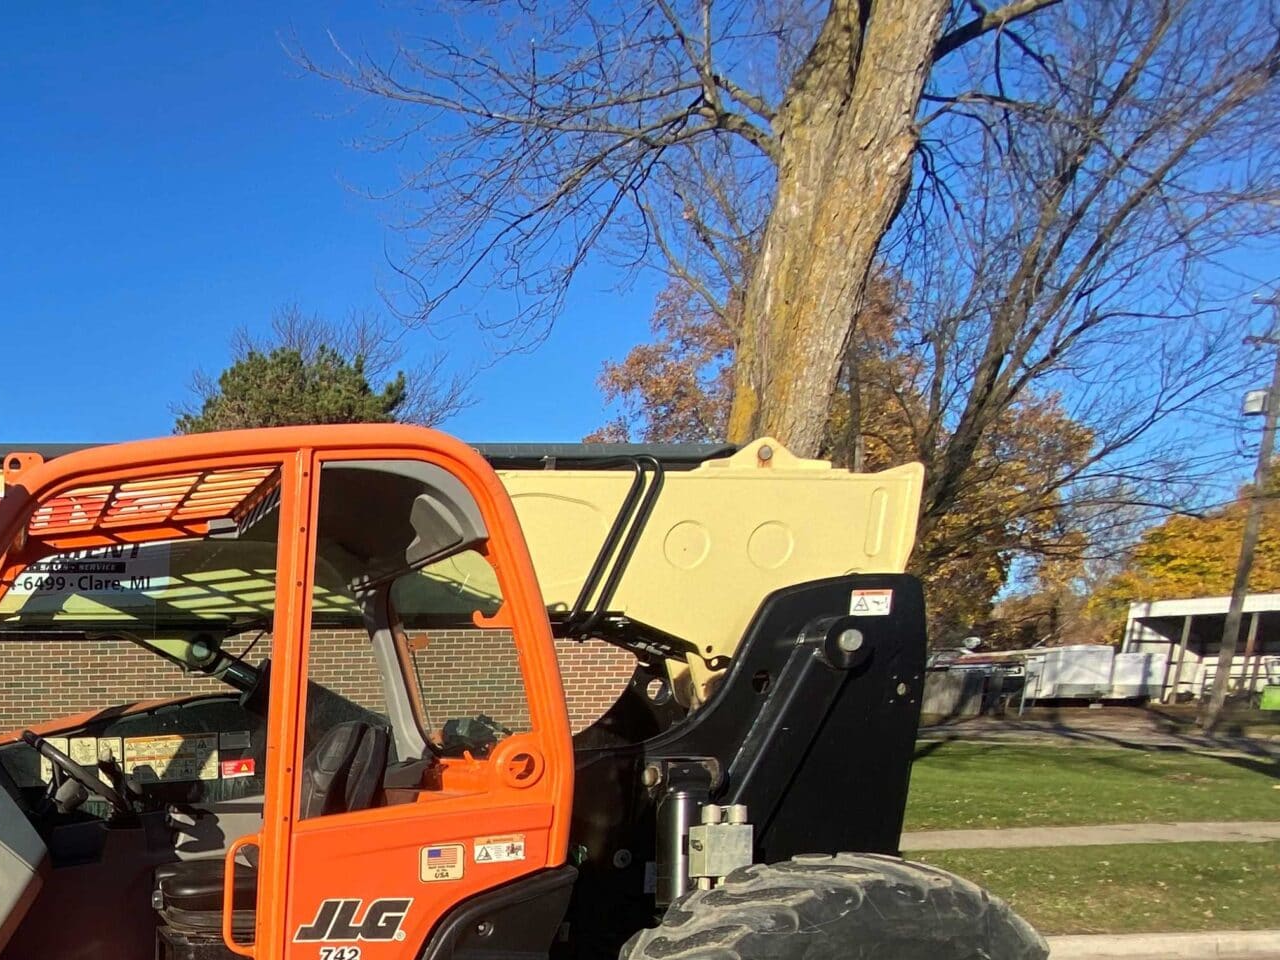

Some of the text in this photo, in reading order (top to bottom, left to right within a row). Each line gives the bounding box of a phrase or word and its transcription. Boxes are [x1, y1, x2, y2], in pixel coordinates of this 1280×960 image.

[77, 575, 125, 592] Clare,
[130, 575, 151, 590] MI
[294, 899, 413, 941] JLG
